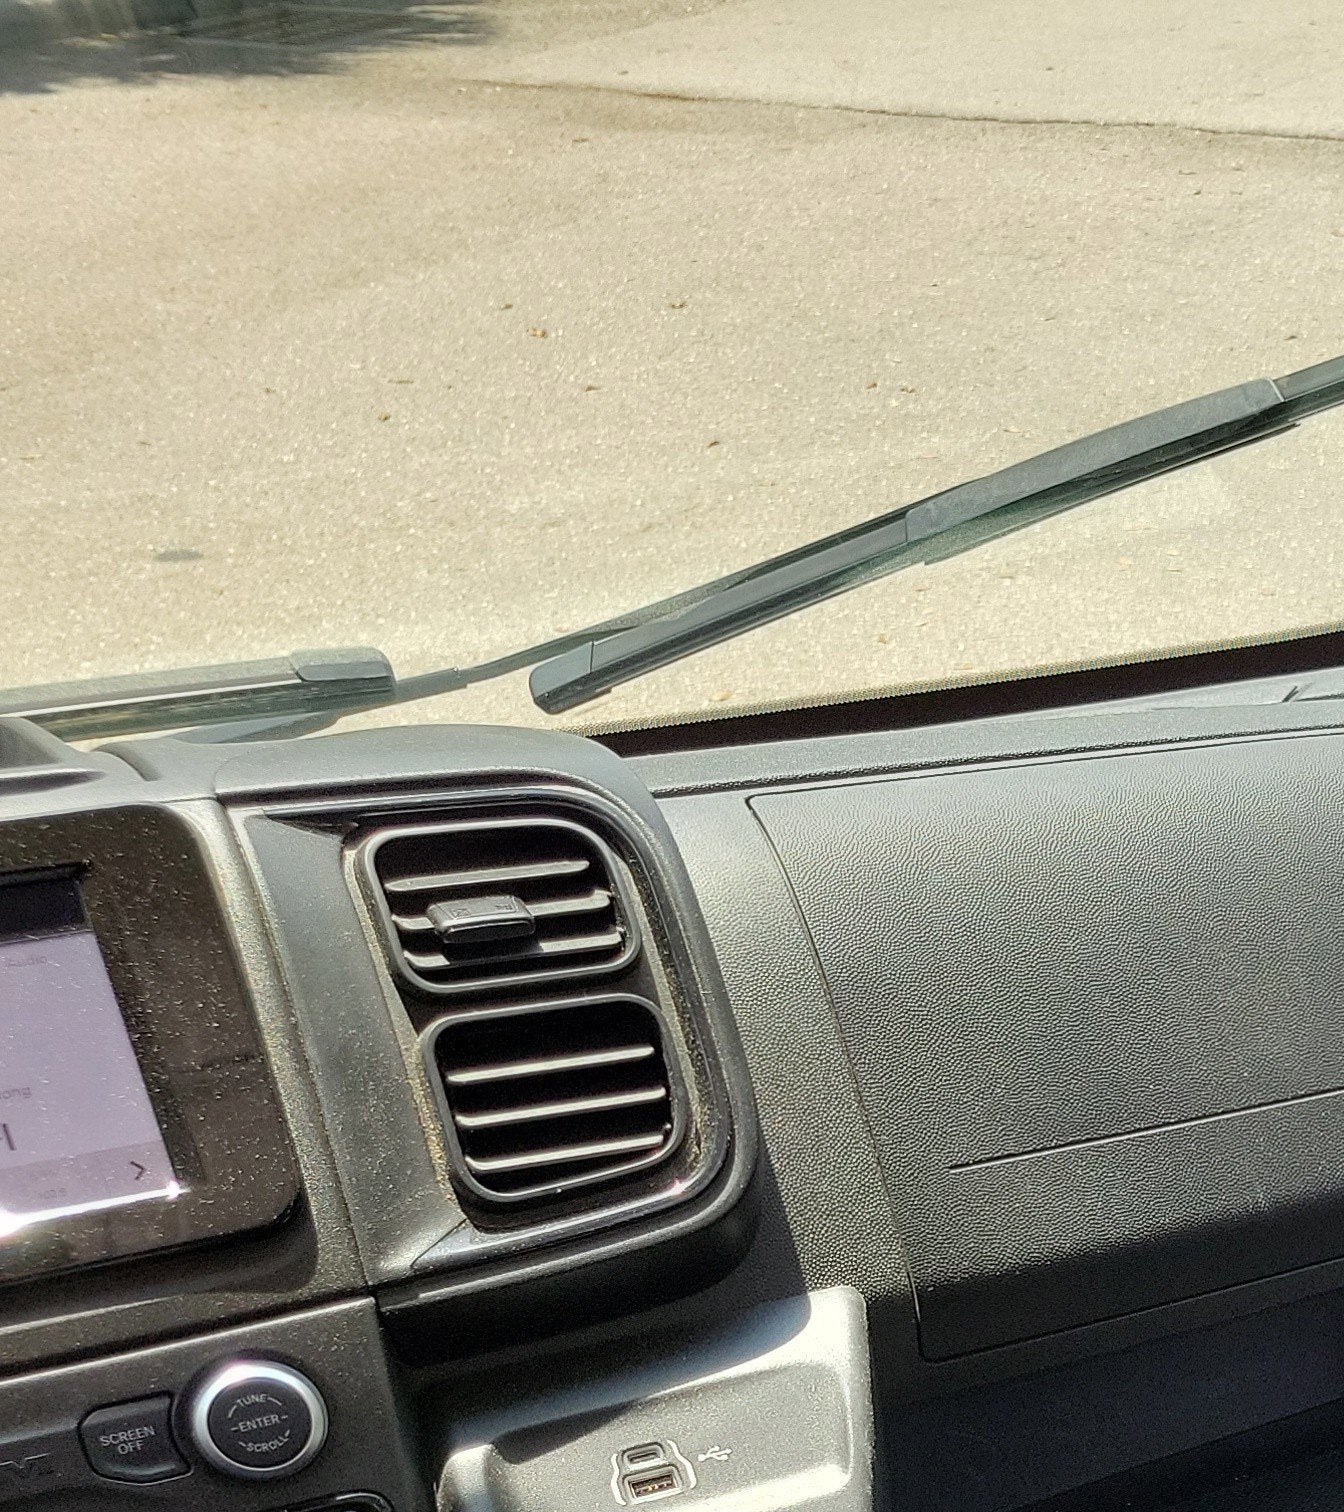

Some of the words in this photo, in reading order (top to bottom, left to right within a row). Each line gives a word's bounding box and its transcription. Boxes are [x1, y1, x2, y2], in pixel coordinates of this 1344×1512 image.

[237, 1393, 267, 1407] TUNE
[239, 1414, 280, 1432] ENTER
[100, 1425, 156, 1447] SCREEN
[246, 1435, 289, 1452] SCROLL
[118, 1440, 144, 1454] OFF
